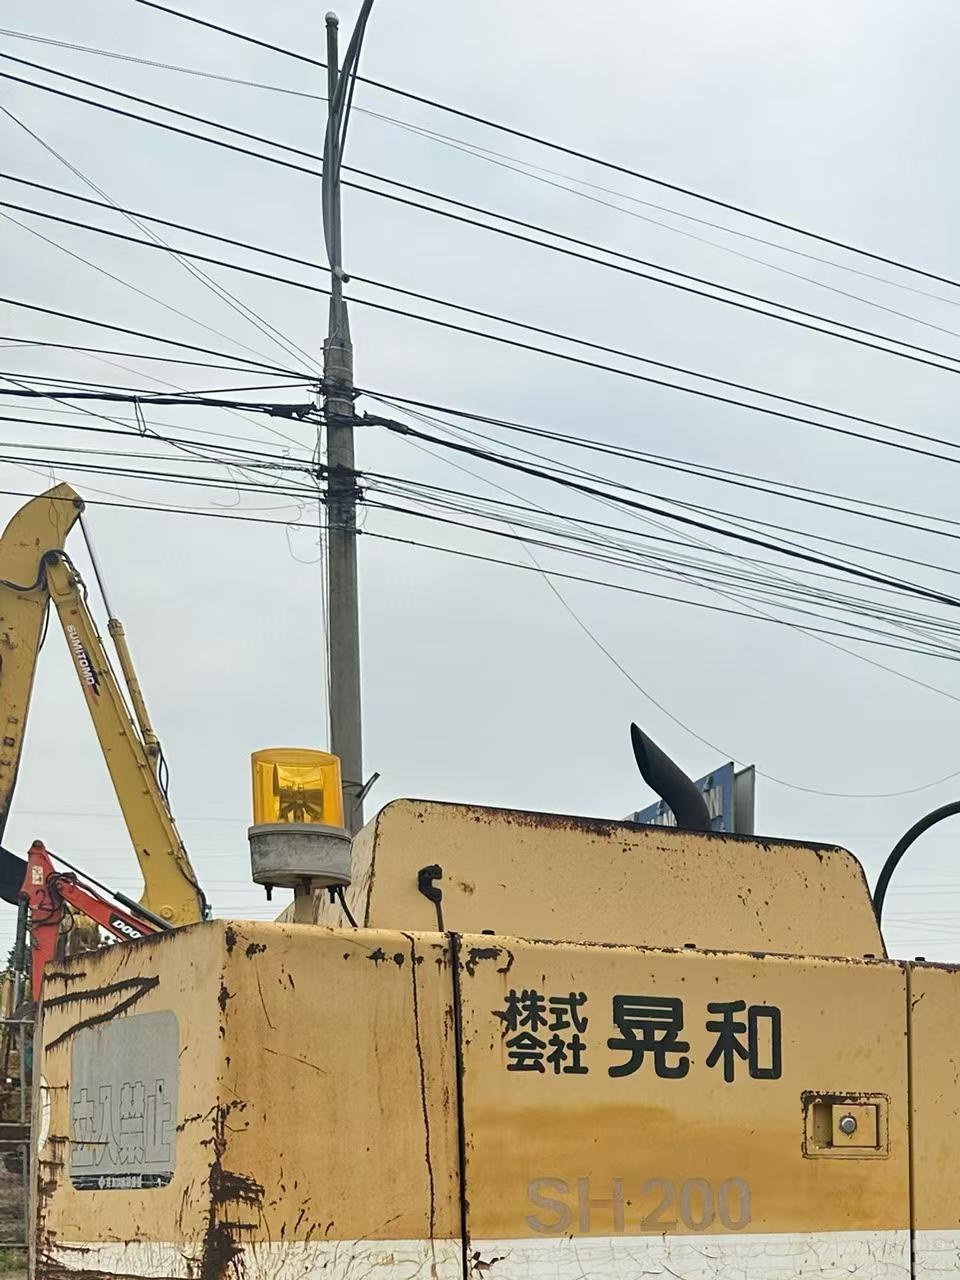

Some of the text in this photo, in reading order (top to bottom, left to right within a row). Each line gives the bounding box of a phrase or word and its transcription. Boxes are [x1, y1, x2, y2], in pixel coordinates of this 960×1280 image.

[66, 623, 95, 686] SUMITOMO
[524, 1176, 752, 1234] SH 200
